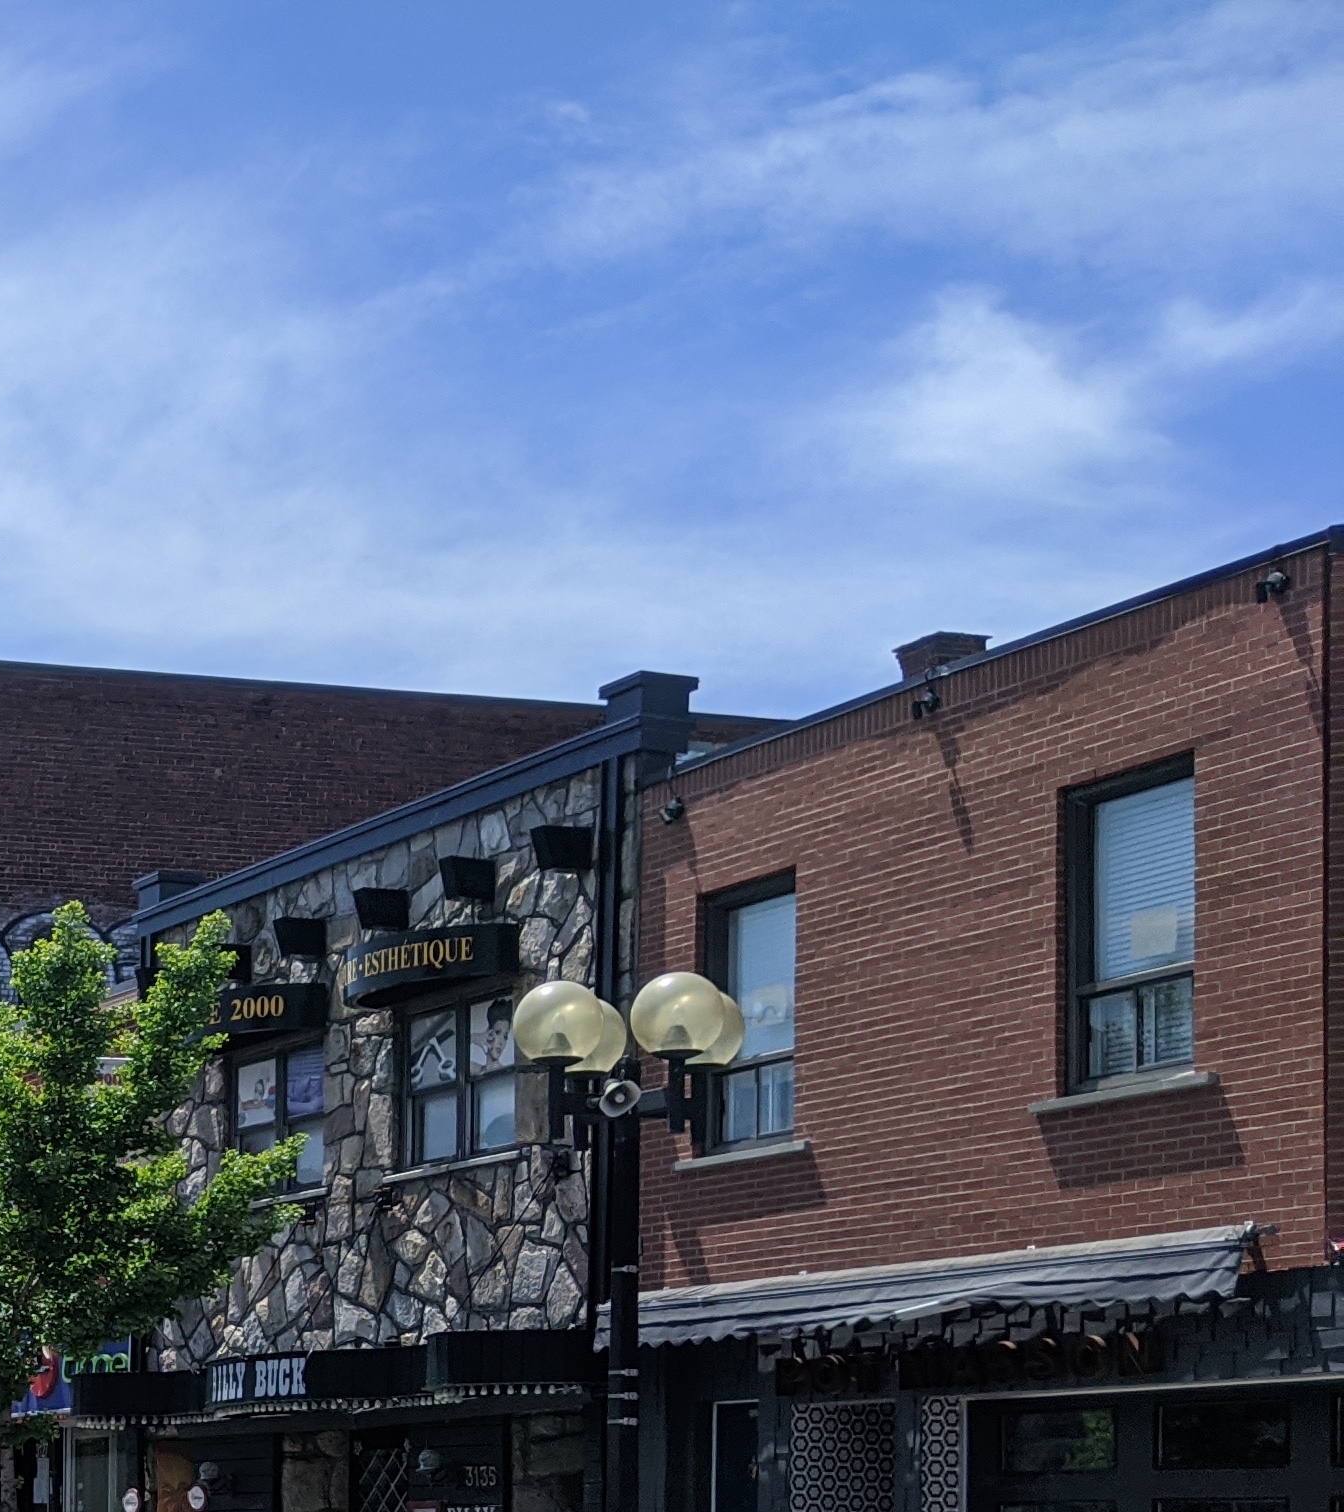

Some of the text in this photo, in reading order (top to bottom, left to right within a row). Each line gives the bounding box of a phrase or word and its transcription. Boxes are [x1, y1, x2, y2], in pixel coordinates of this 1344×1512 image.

[364, 937, 474, 978] ESTHÉTIQUE
[230, 994, 285, 1021] 2000
[212, 1357, 307, 1403] BILLY BUCK
[464, 1465, 497, 1488] 3135
